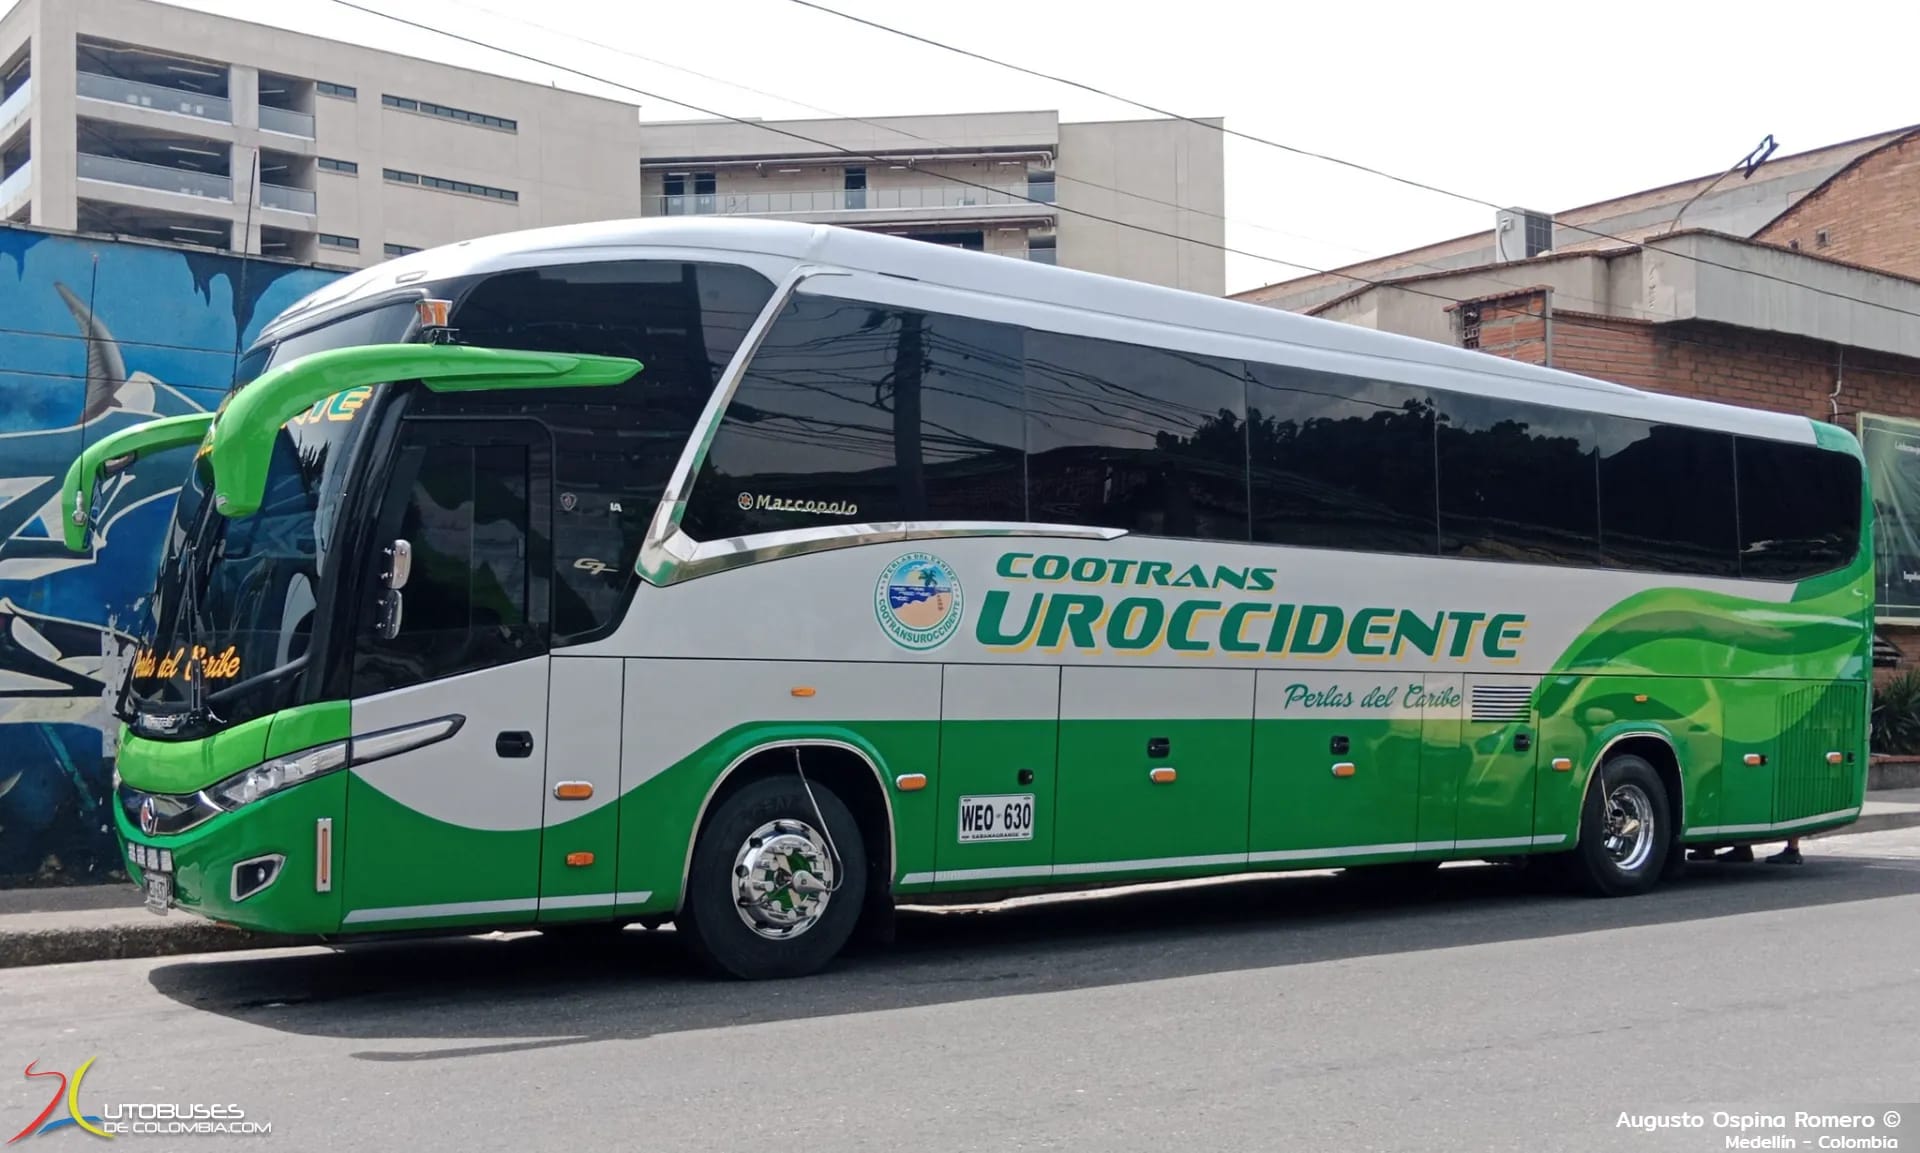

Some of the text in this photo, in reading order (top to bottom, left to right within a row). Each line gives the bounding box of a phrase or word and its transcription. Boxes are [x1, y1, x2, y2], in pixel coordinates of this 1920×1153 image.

[756, 494, 858, 515] Marcopolo
[996, 552, 1278, 593] COOTRANS
[879, 598, 961, 644] COOTRANSUROCCIDENTE
[976, 590, 1532, 665] UROCCIDENTE
[1284, 683, 1462, 710] Perlas del Caribe
[961, 803, 1032, 832] WEO 630
